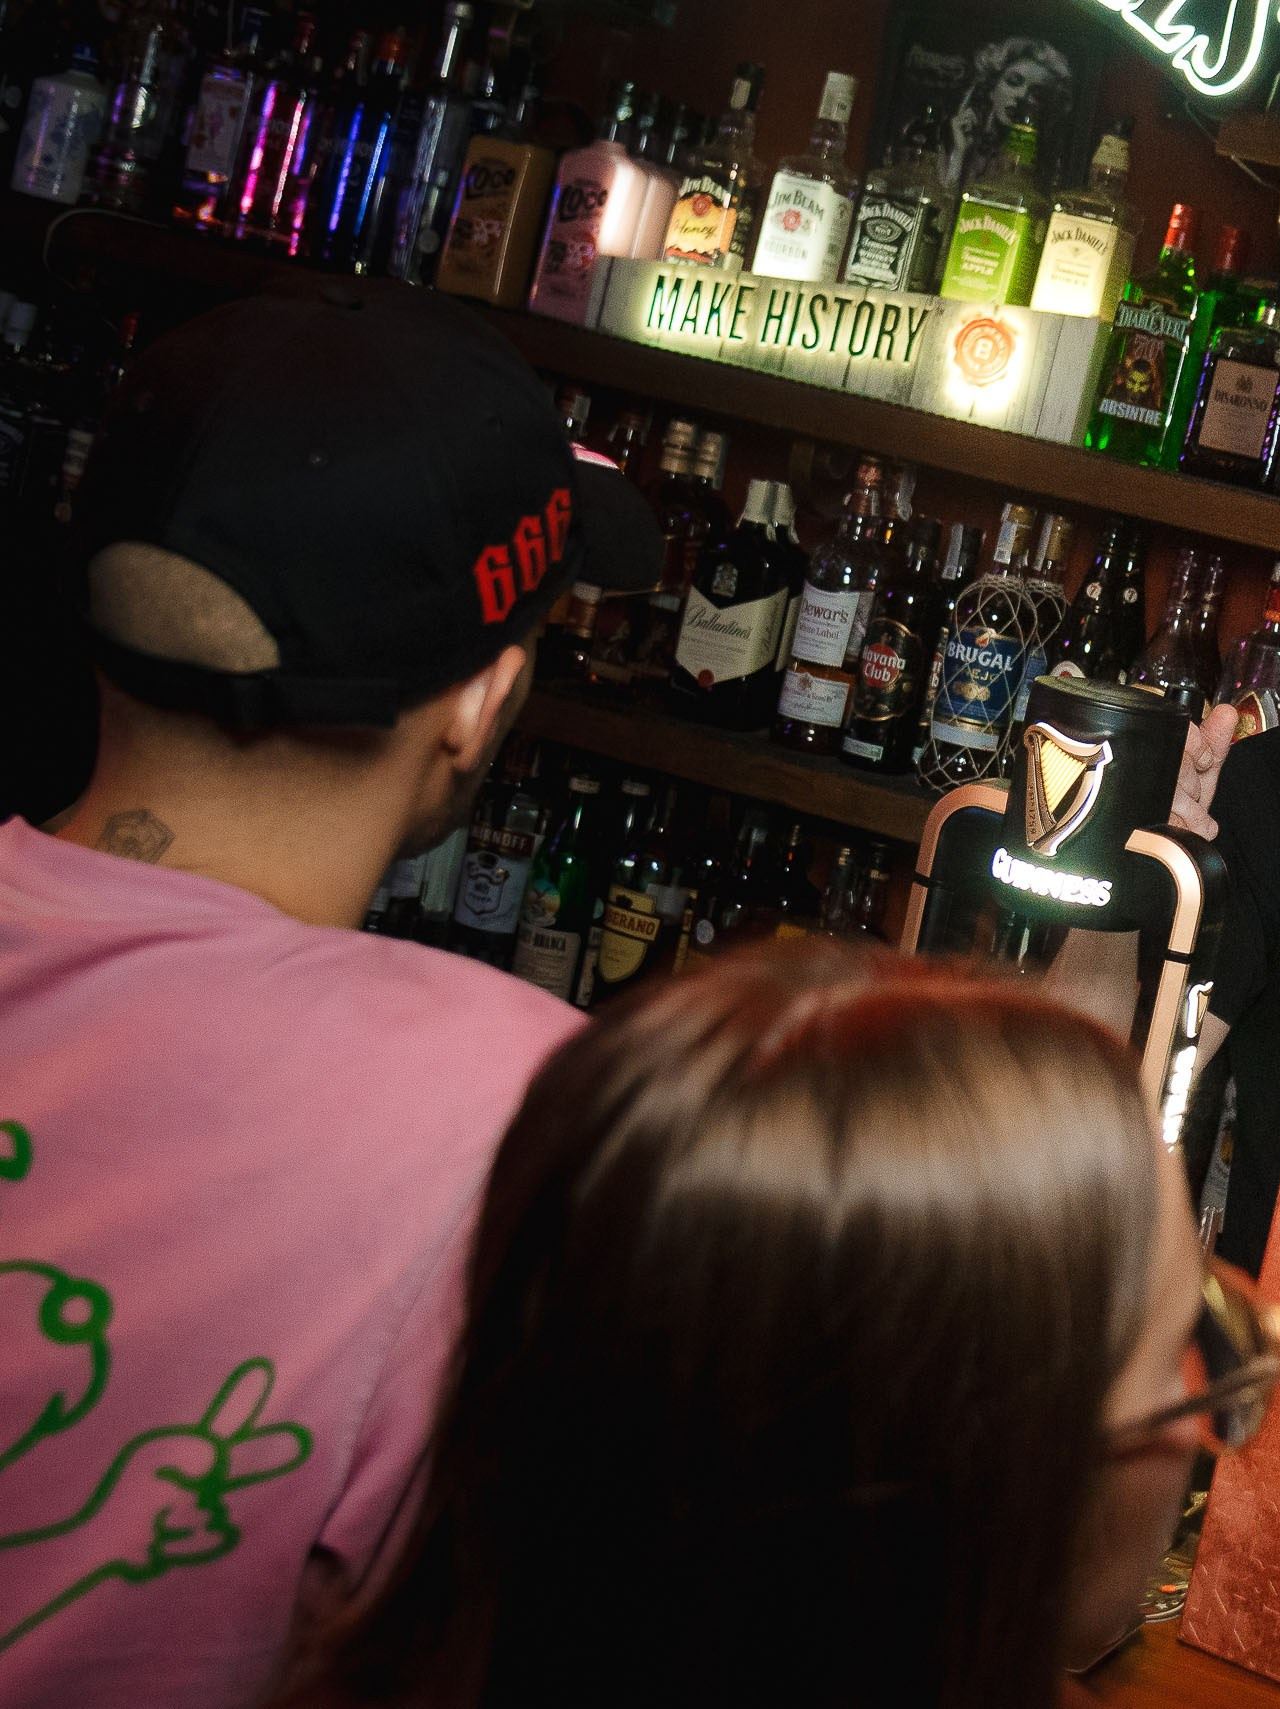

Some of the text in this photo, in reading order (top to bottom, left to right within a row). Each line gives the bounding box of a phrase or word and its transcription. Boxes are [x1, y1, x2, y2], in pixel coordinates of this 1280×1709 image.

[647, 274, 932, 364] MAKE HISTORY
[472, 486, 573, 624] 666
[863, 662, 892, 683] Club
[948, 640, 1014, 673] BRUGAL
